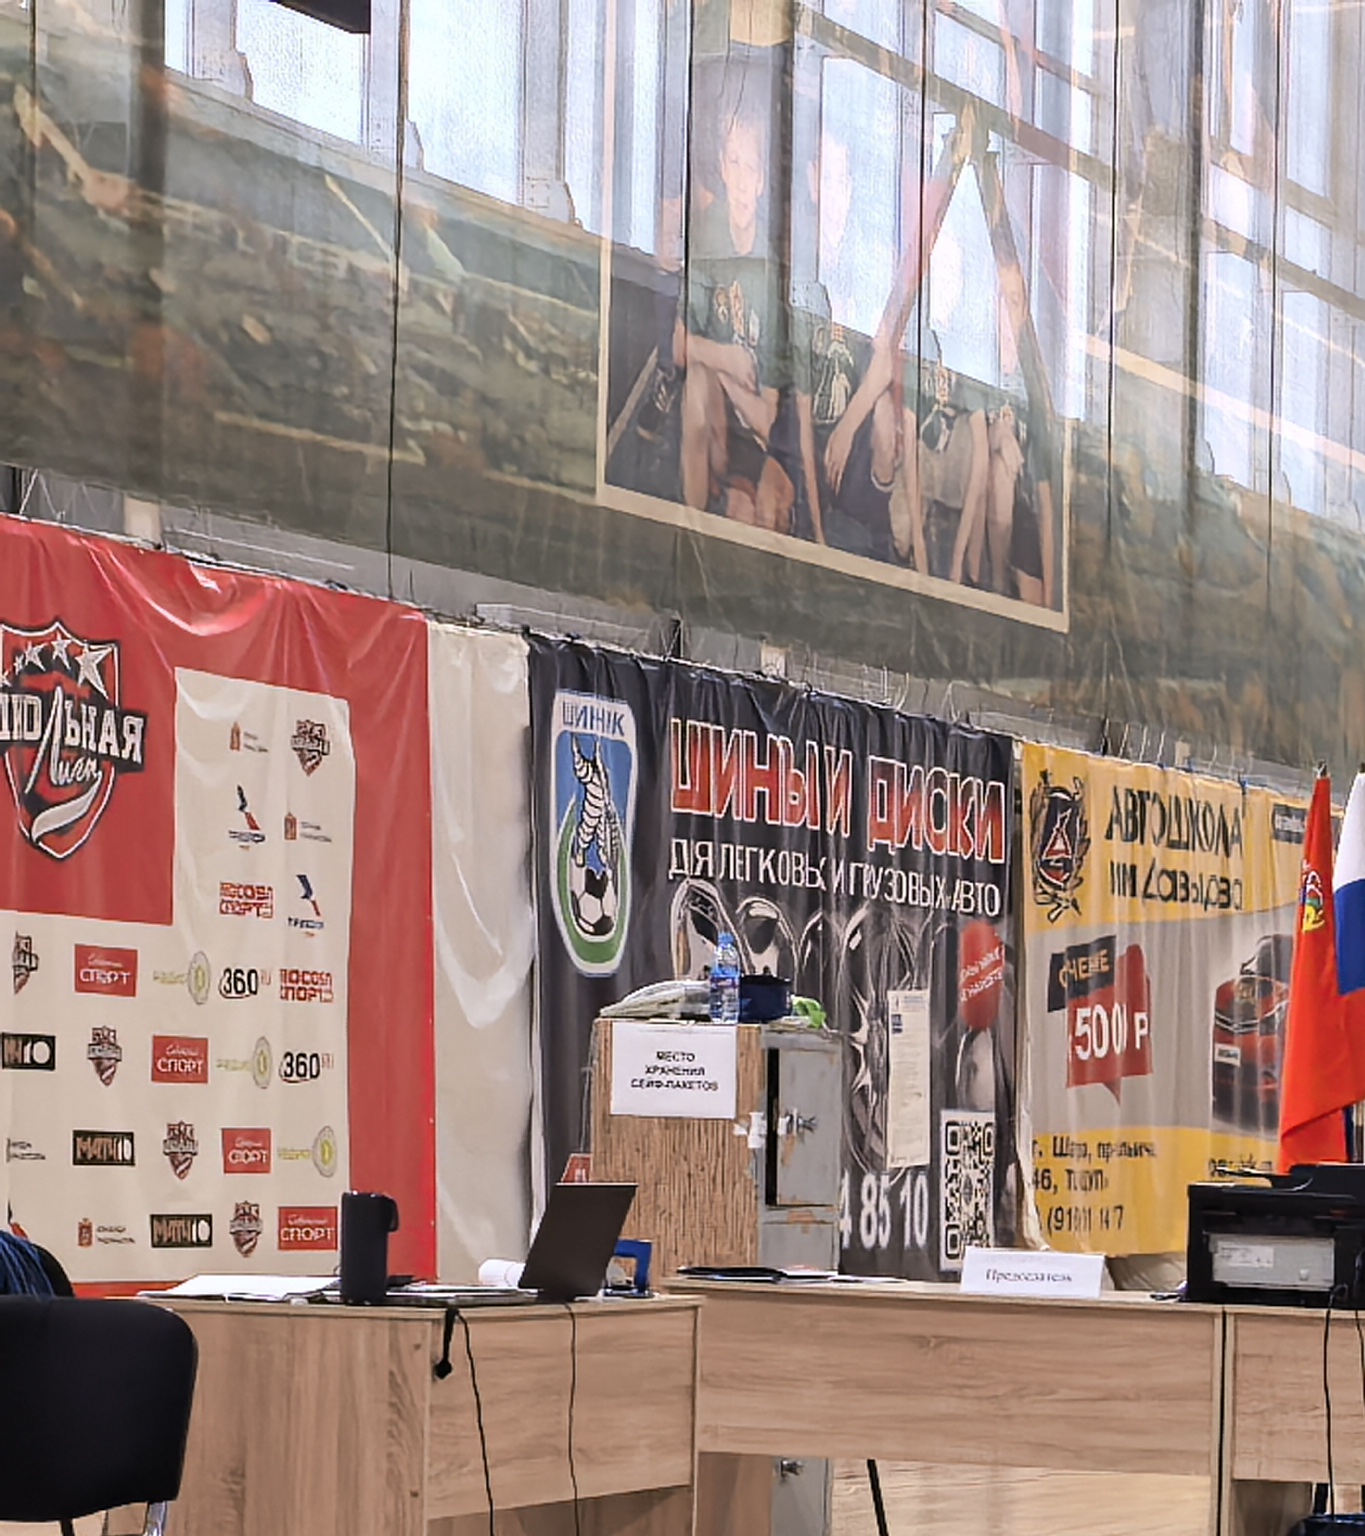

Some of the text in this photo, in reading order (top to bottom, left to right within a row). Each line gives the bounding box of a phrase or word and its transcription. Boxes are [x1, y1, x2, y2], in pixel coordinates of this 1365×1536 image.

[671, 717, 1005, 864] ШИНЫ И ДИСКИ
[951, 878, 1000, 917] АВТО
[223, 968, 259, 996] 360
[283, 1051, 321, 1079] 360
[859, 1170, 892, 1249] 85
[899, 1170, 928, 1249] 10
